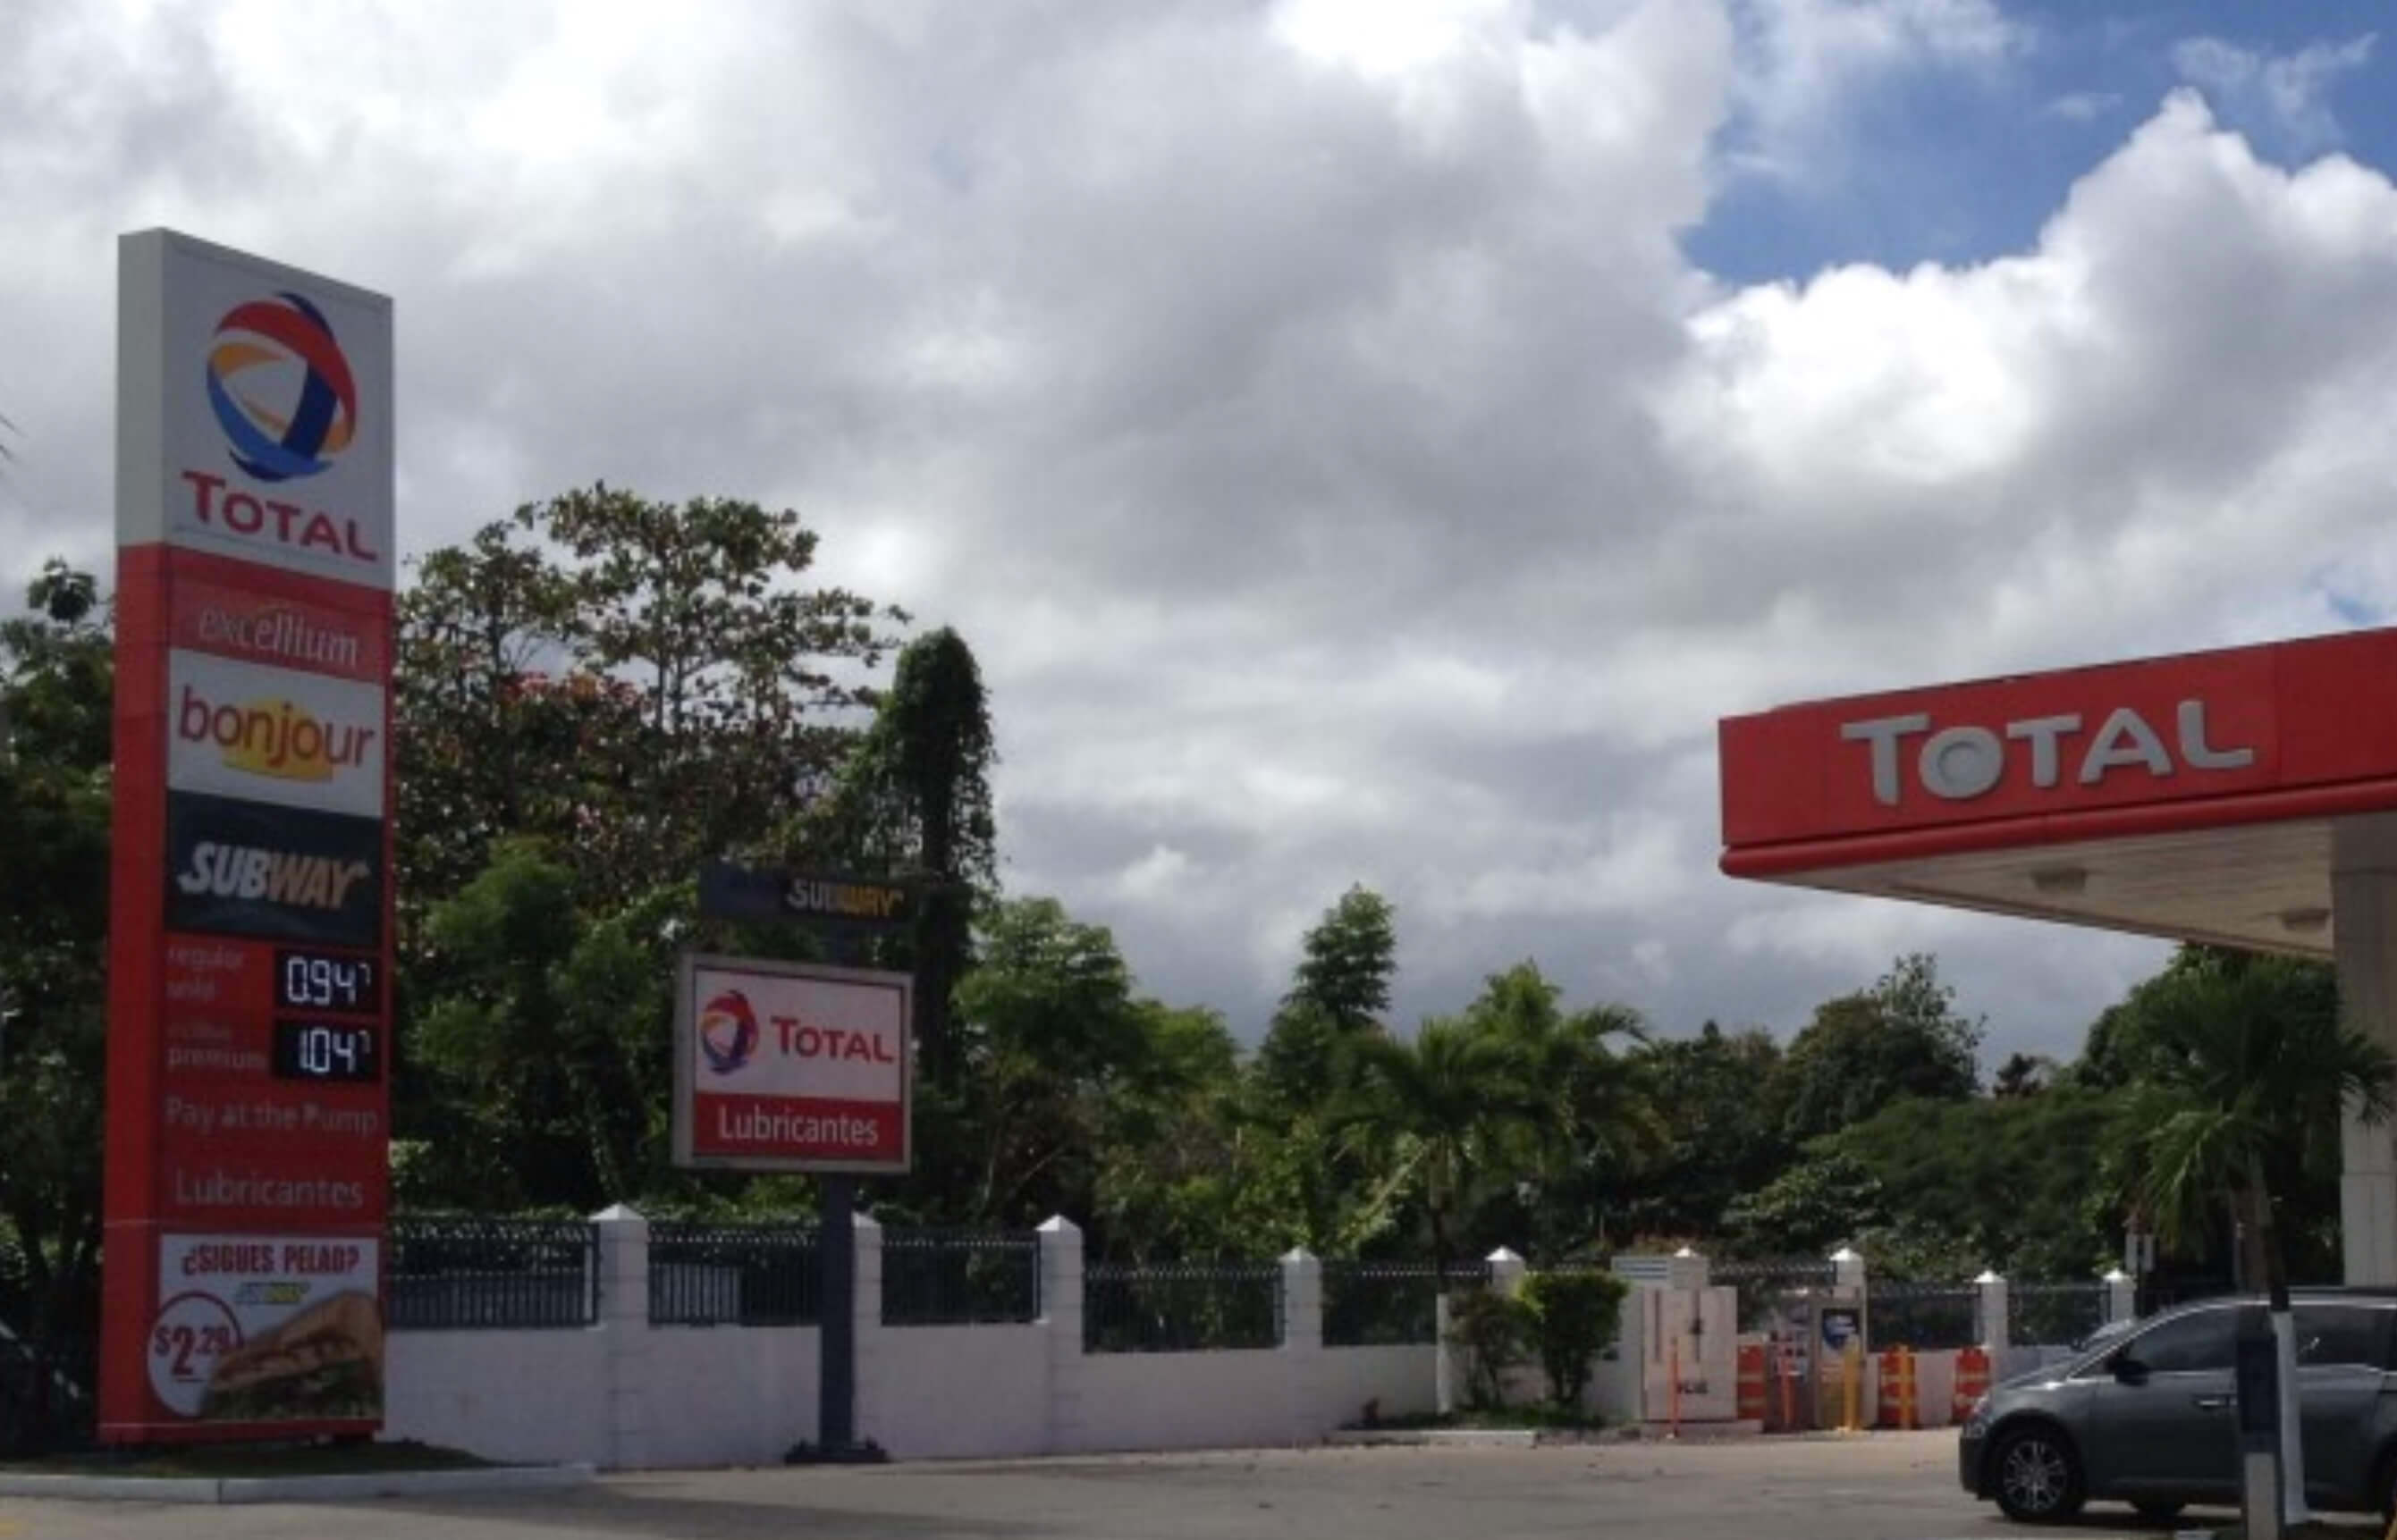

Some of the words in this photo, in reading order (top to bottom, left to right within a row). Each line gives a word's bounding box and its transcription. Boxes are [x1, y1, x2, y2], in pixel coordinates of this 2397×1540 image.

[182, 469, 378, 562] TOTAL
[198, 604, 359, 667] excellium
[180, 683, 376, 770] bonjour
[1841, 700, 2256, 805] TOTAL
[177, 841, 370, 910] SUBWAY
[770, 1015, 894, 1063] TOTAL
[719, 1104, 880, 1146] Lubricantes
[175, 1166, 364, 1208] Lubricantes
